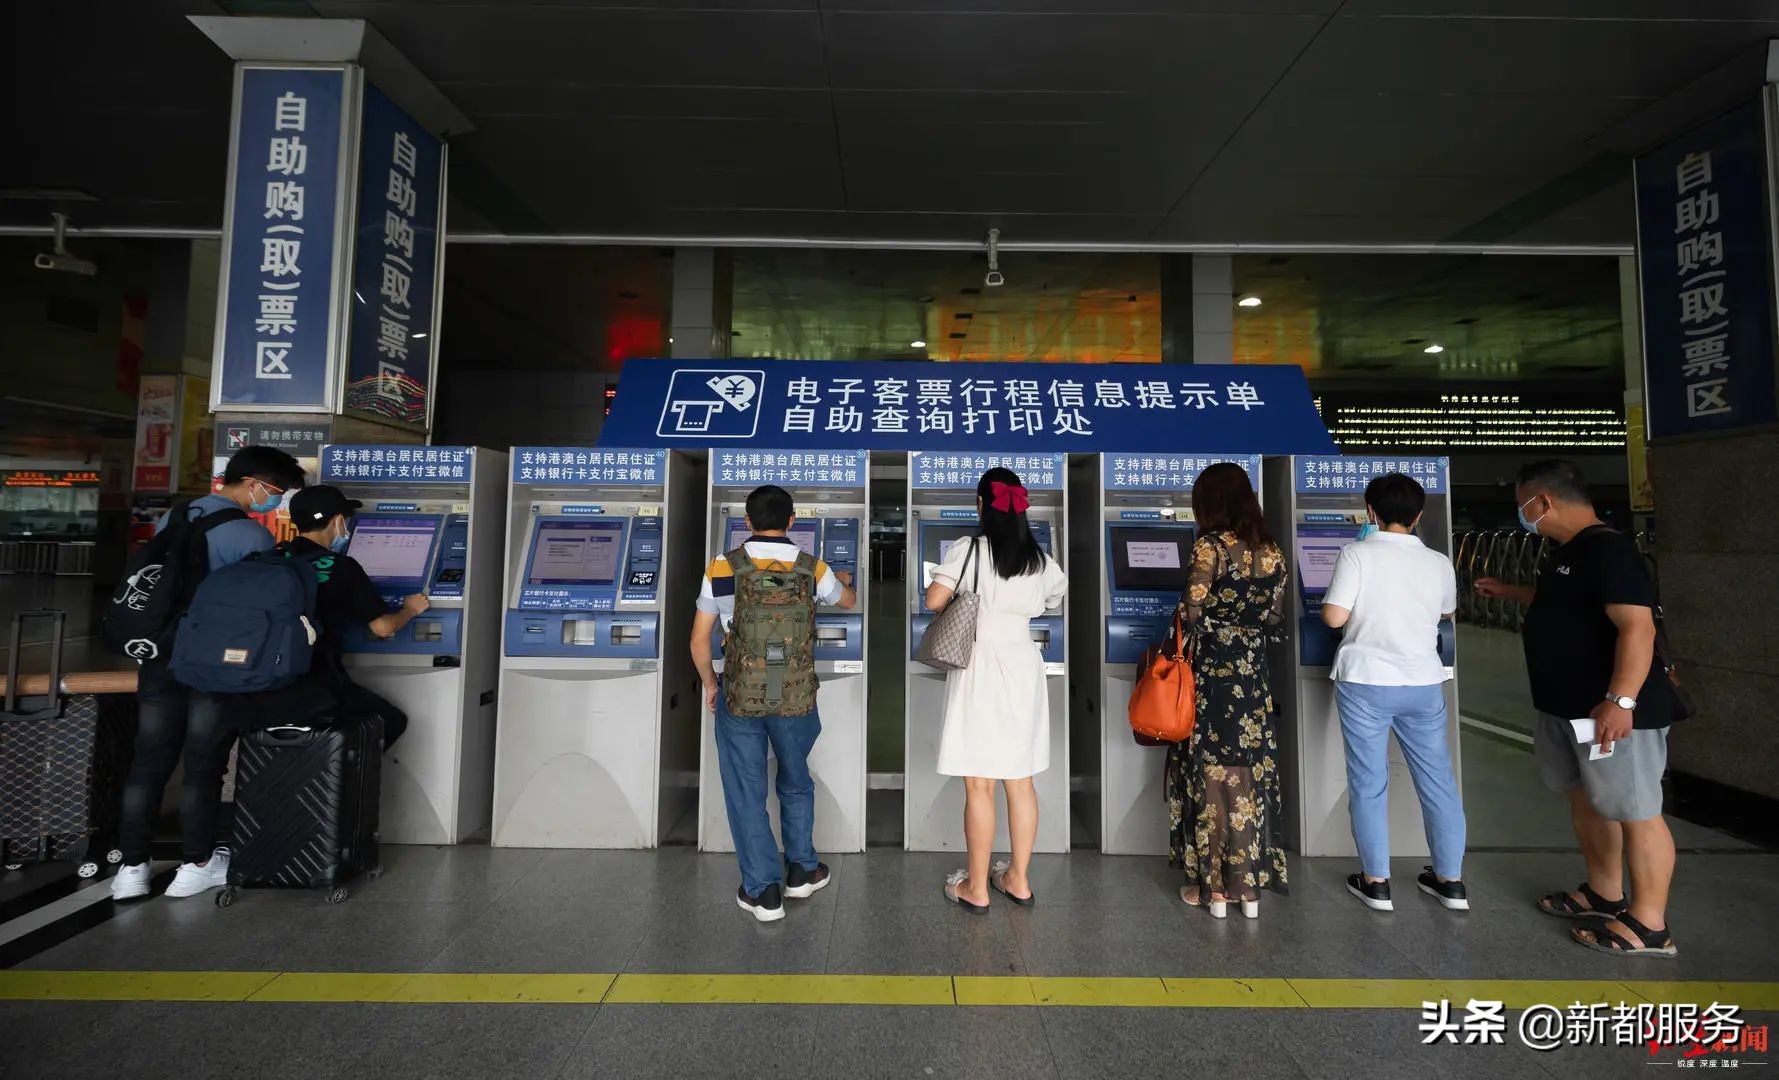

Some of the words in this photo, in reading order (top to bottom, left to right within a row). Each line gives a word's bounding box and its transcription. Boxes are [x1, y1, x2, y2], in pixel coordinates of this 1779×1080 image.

[255, 92, 307, 379] 自助购(取)票区
[377, 131, 416, 404] 自助购(取)票区
[1674, 151, 1732, 418] 自助购(取)票区
[787, 376, 1266, 411] 电子客票行程信息提示单
[783, 405, 1094, 436] 自助查询打印处
[260, 430, 324, 441] 请勿携带宠物
[331, 449, 464, 463] 支持港澳台居民居住证
[521, 452, 656, 465] 支持港澳台居民居住证
[721, 453, 857, 467] 支持港澳台居民居住证
[857, 451, 866, 459] 39
[1054, 454, 1063, 462] 38
[919, 456, 1054, 470] 支持港澳台居民居住证
[1305, 461, 1437, 474] 支持港澳台居民居住证
[331, 464, 464, 477] 支持银行卡支付宝微信
[521, 467, 656, 481] 支持银行卡支付宝微信
[721, 468, 857, 482] 支持银行卡支付宝微信
[919, 471, 1054, 484] 支持银行卡宝微信
